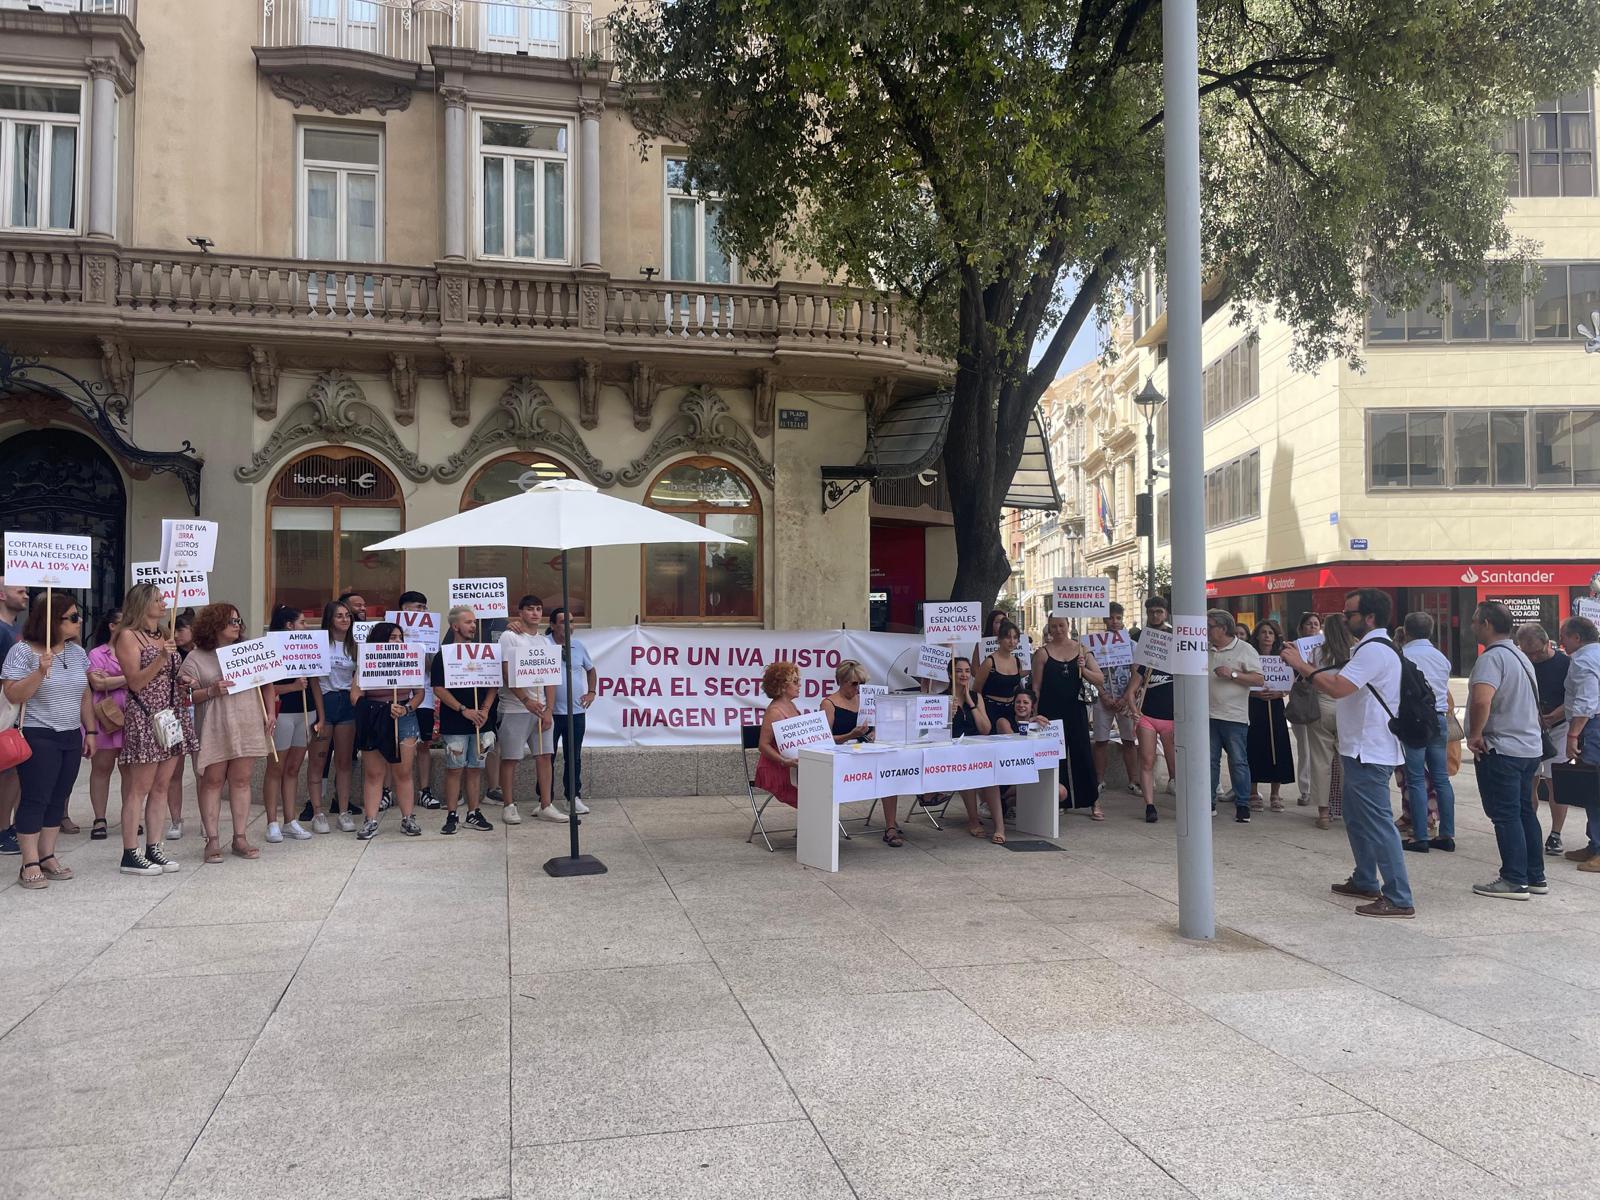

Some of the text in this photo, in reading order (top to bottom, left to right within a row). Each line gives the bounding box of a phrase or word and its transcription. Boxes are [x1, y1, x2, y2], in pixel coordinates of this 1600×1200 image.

[293, 473, 347, 486] iberCaja
[8, 540, 53, 550] CORTARSE
[66, 544, 88, 552] PELO
[8, 549, 89, 561] ES UNA NECESIDAD
[7, 559, 89, 572] ¡IVA AL 10% YA!
[1481, 570, 1555, 583] Santander
[452, 582, 504, 591] SERVICIOS
[1273, 578, 1296, 589] Santander
[181, 588, 206, 597] 10%
[452, 591, 505, 599] ESENCIALES
[473, 603, 485, 611] AL
[487, 602, 506, 610] 10%
[1057, 601, 1105, 609] ESENCIAL
[1527, 597, 1541, 605] ESTÁ
[938, 605, 968, 614] SOMOS
[395, 612, 434, 628] IVA
[930, 615, 976, 624] ESENCIALES
[926, 625, 941, 633] ¡IVA
[953, 624, 967, 632] 10%
[968, 624, 980, 632] YA!
[1088, 630, 1125, 647] IVA
[231, 641, 265, 657] SOMOS
[284, 643, 318, 651] VOTAMOS
[400, 643, 408, 651] EN
[456, 644, 496, 660] IVA
[1176, 640, 1197, 652] ¡EN
[225, 650, 276, 670] ESENCIALES
[282, 653, 321, 661] NOSOTROS
[519, 657, 556, 667] BARBERÍAS
[630, 646, 841, 668] POR UN IVA JUSTO
[242, 668, 252, 676] AL
[254, 663, 269, 673] 10%
[268, 659, 283, 668] YA!
[365, 660, 418, 669] LOS COMPAÑEROS
[1262, 665, 1284, 673] ÉTICA
[528, 667, 536, 675] AL
[536, 667, 549, 675] 10%
[1263, 674, 1290, 682] UCHA!
[598, 677, 836, 698] PARA EL SECT DE
[622, 707, 716, 728] IMAGEN
[780, 718, 822, 732] SOBREVIVIMOS
[782, 725, 825, 740] POR LOS PELOS
[796, 738, 808, 746] AL
[808, 734, 821, 743] 10%
[821, 731, 832, 740] YA!
[843, 750, 1060, 783] AHORA VOTAMOS NOSOTROS AHORA VOTAMOS NOSOTROS
